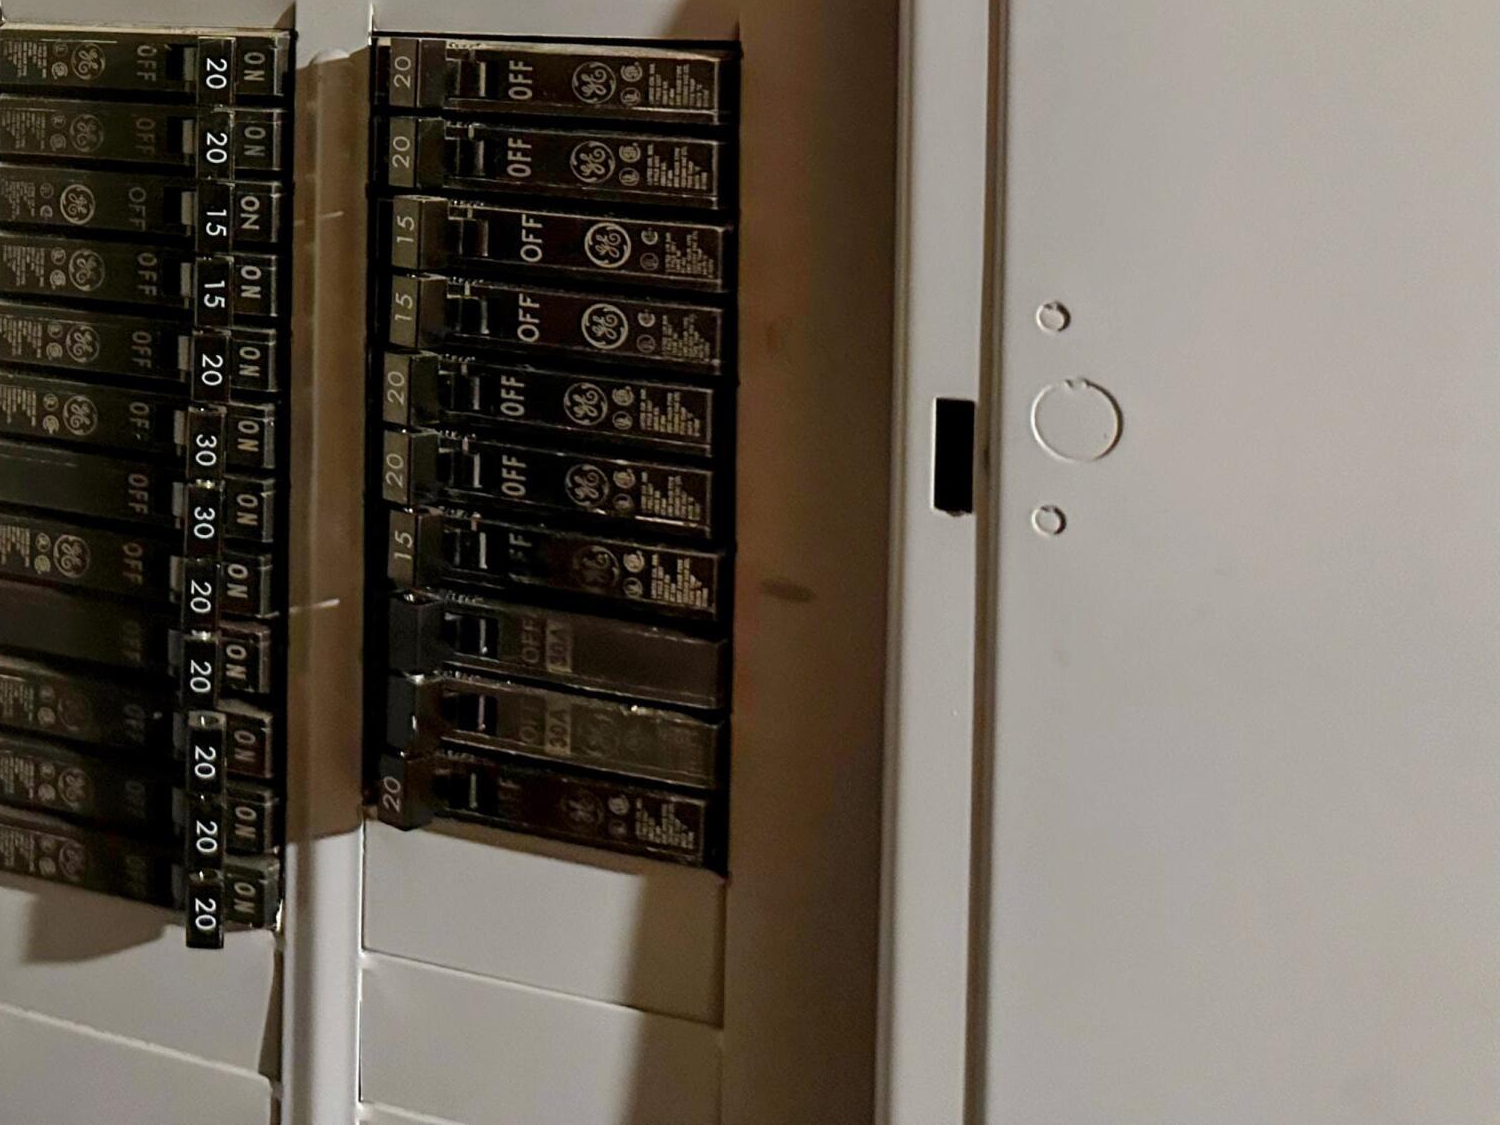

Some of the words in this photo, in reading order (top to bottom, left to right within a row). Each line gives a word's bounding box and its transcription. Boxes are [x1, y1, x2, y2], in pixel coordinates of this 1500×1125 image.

[137, 45, 157, 80] OFF
[206, 58, 227, 89] 20
[244, 52, 265, 80] ON
[394, 56, 411, 88] 20
[508, 61, 532, 99] OFF
[207, 133, 227, 163] 20
[244, 127, 265, 156] ON
[392, 136, 410, 168] 20
[507, 138, 531, 177] OFF
[129, 187, 146, 231] OFF
[206, 210, 226, 236] 15
[241, 196, 259, 229] ON
[397, 216, 414, 242] 15
[521, 214, 543, 262] OFF
[138, 253, 157, 295] OFF
[241, 266, 261, 298] ON
[204, 281, 225, 307] 15
[395, 293, 413, 320] 15
[517, 294, 539, 343] OFF
[132, 331, 151, 368] OFF
[239, 347, 260, 376] ON
[202, 354, 223, 385] 20
[388, 371, 405, 405] 20
[500, 376, 524, 416] OFF
[196, 435, 217, 466] 30
[238, 421, 259, 451] ON
[386, 454, 403, 487] 20
[502, 455, 526, 496] OFF
[129, 474, 148, 513] OFF
[194, 507, 215, 538] 30
[237, 495, 258, 525] ON
[394, 531, 413, 559] 15
[123, 543, 142, 583] OFF
[191, 580, 211, 613] 20
[228, 564, 248, 598] ON
[190, 660, 211, 692] 20
[226, 645, 246, 679] ON
[195, 746, 216, 778] 20
[234, 731, 255, 761] ON
[383, 777, 401, 812] 20
[196, 821, 217, 853] 20
[235, 807, 256, 838] ON
[234, 883, 255, 913] ON
[195, 899, 216, 930] 20
